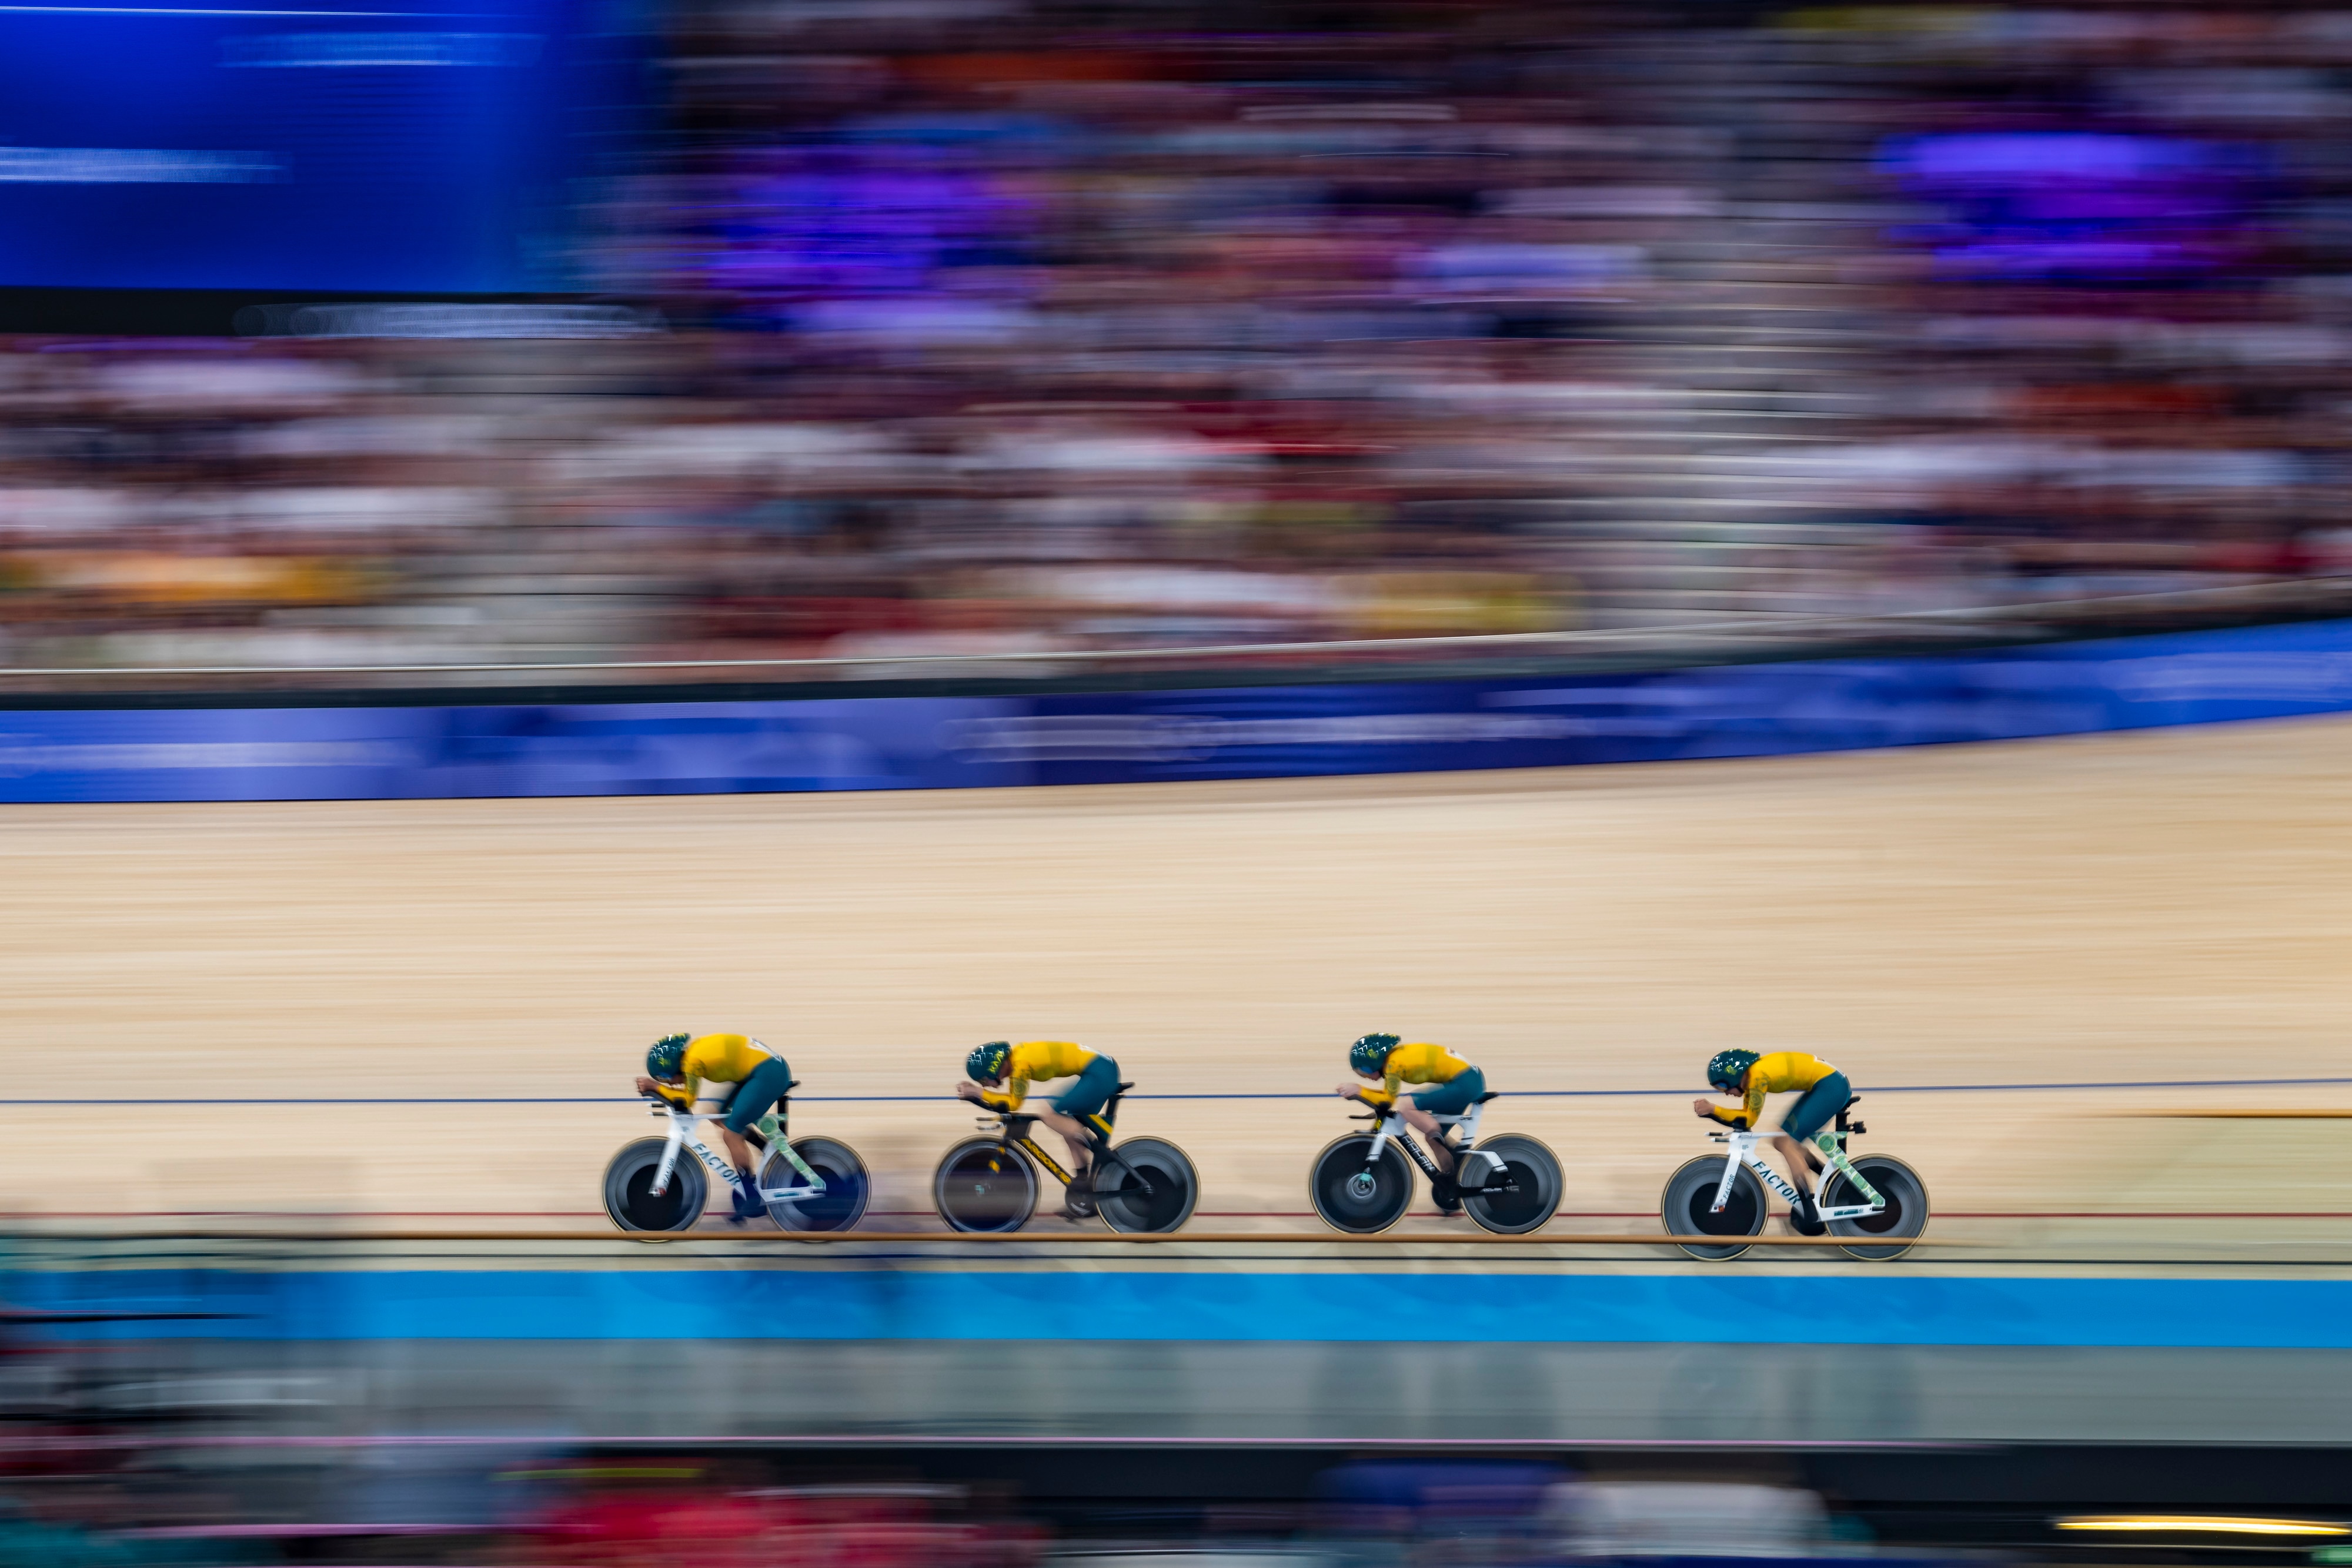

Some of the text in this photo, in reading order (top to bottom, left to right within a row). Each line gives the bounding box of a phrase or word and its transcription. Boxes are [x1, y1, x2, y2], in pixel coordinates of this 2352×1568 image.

[692, 1143, 741, 1185] FACTOR
[1402, 1135, 1435, 1172] DOLAN
[1723, 1174, 1735, 1199] FACTOR
[1752, 1161, 1802, 1205] FACTOR
